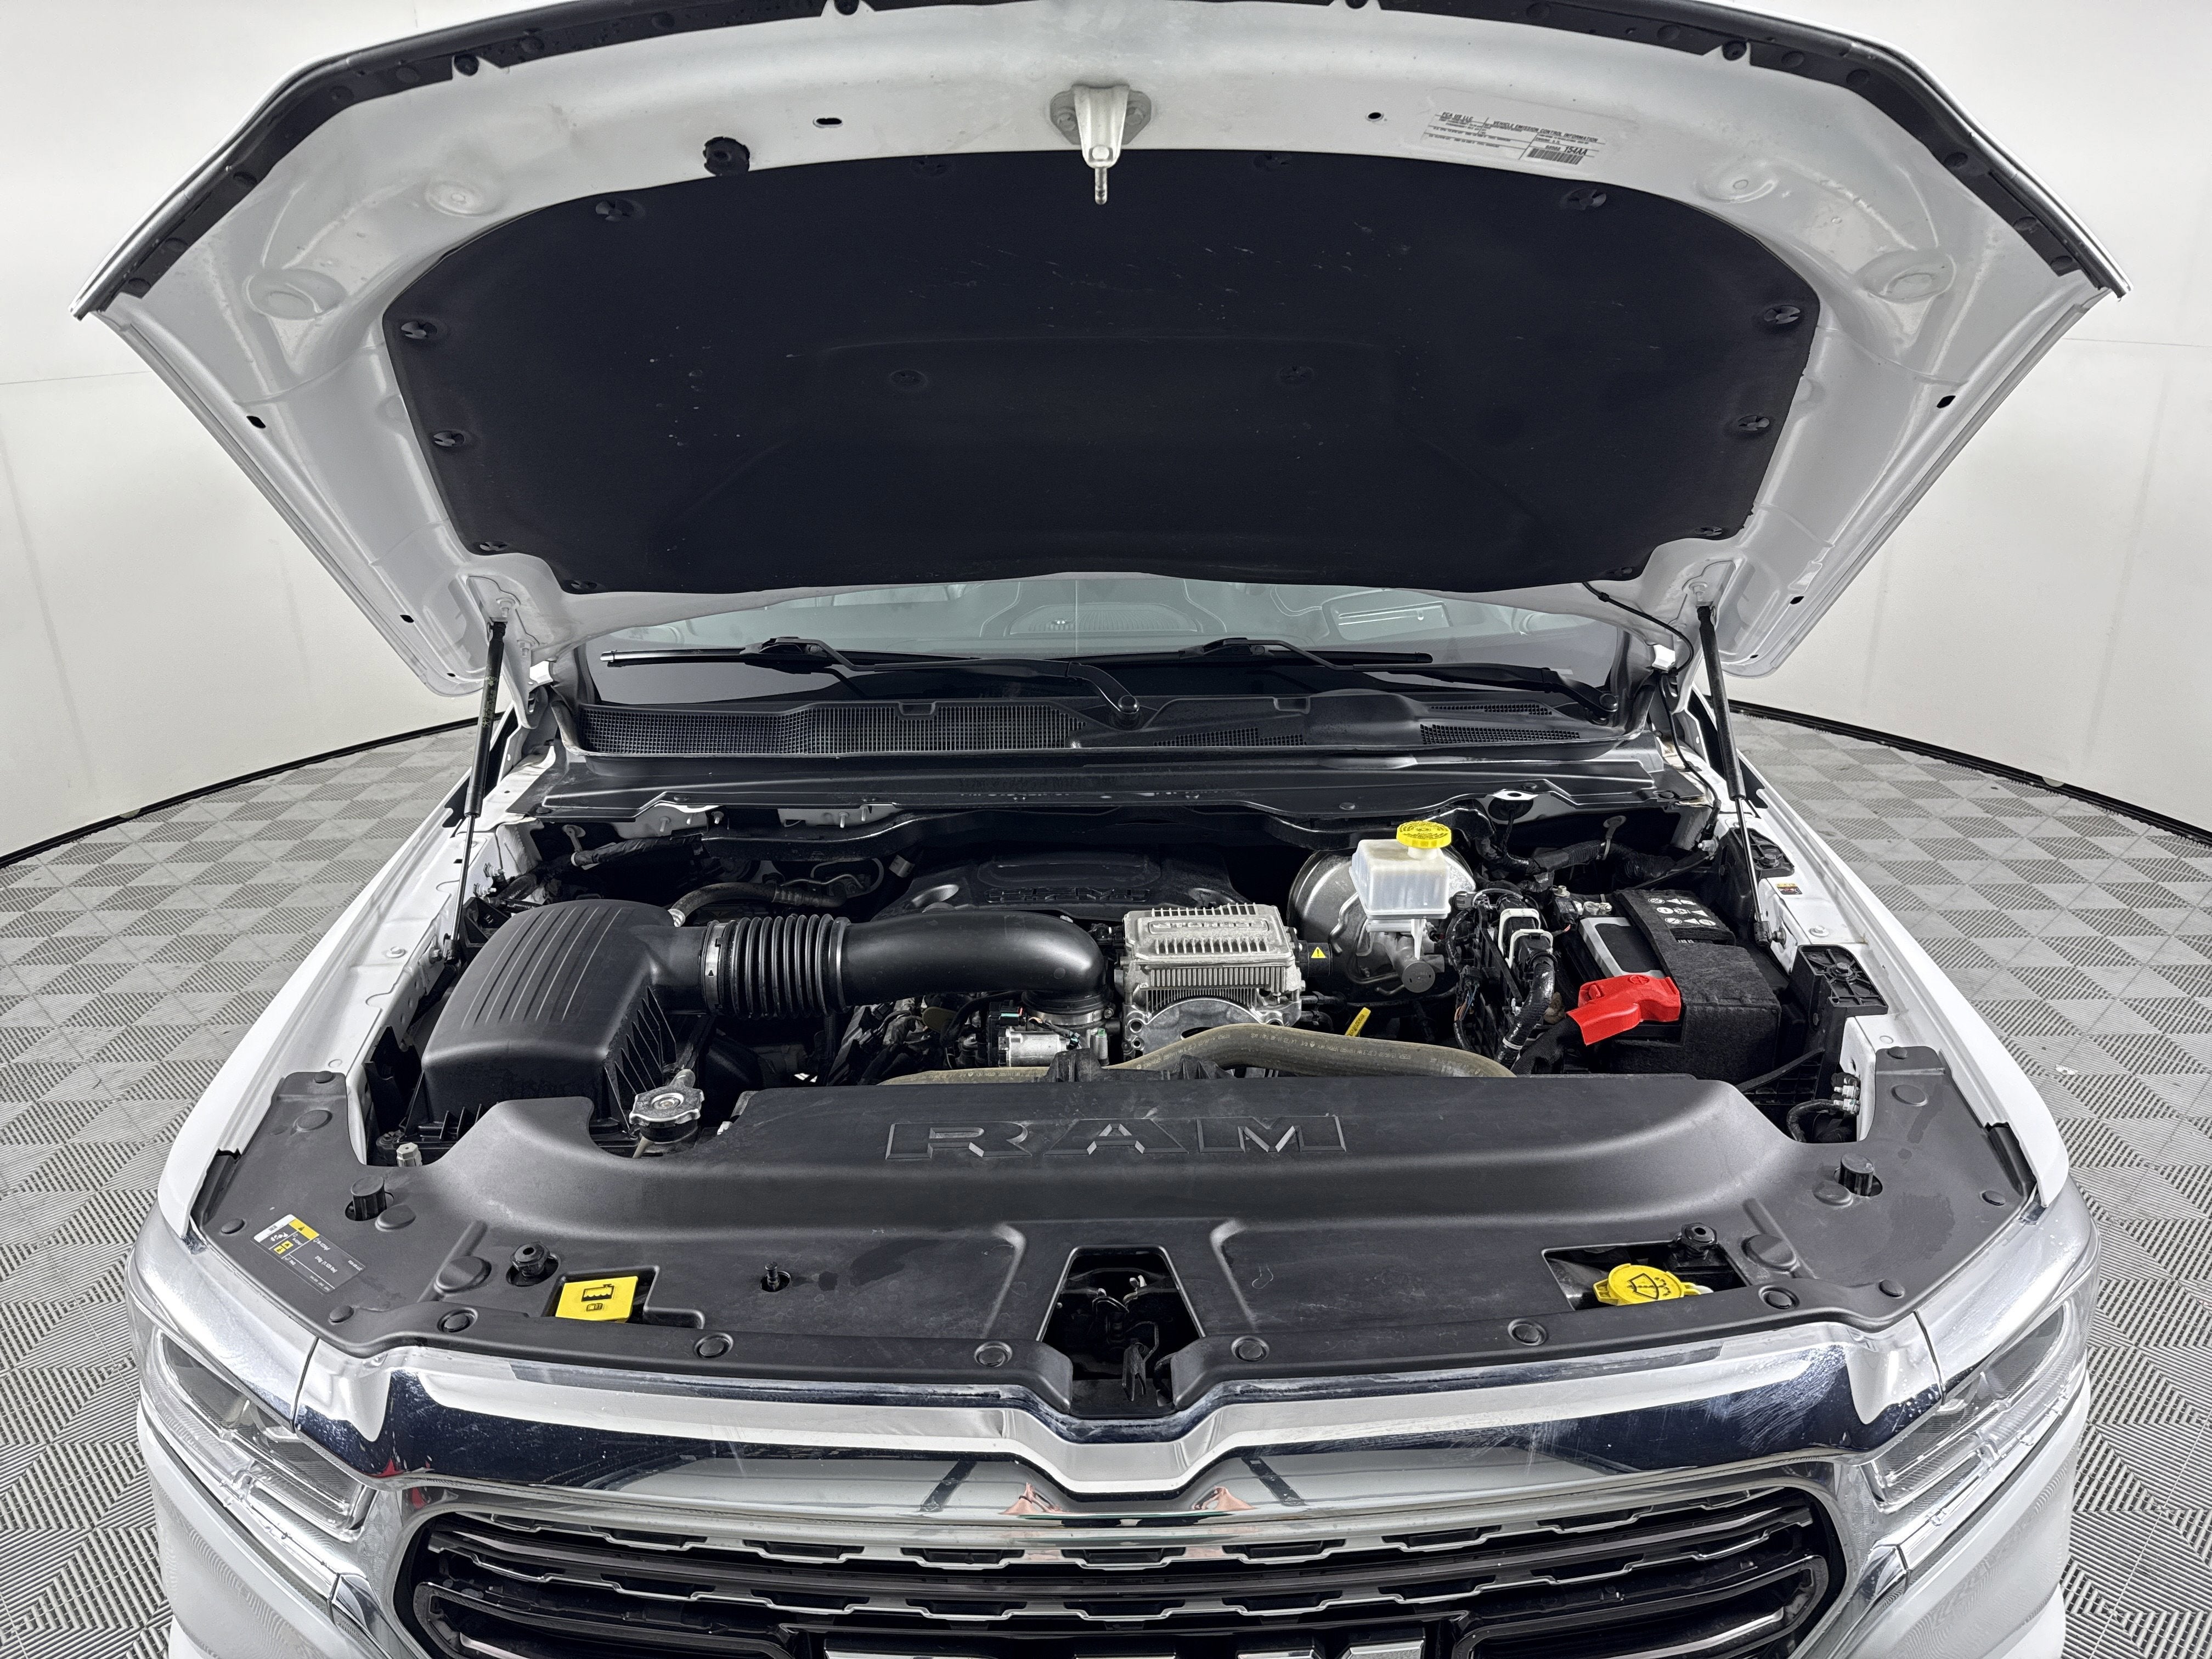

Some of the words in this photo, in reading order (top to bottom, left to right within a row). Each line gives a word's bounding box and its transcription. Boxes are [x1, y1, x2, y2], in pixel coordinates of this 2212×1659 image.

[1493, 121, 1515, 130] VEHICLE
[1563, 133, 1599, 143] INFORMATION
[1564, 146, 1588, 156] 154AA
[885, 1115, 1347, 1160] RAM
